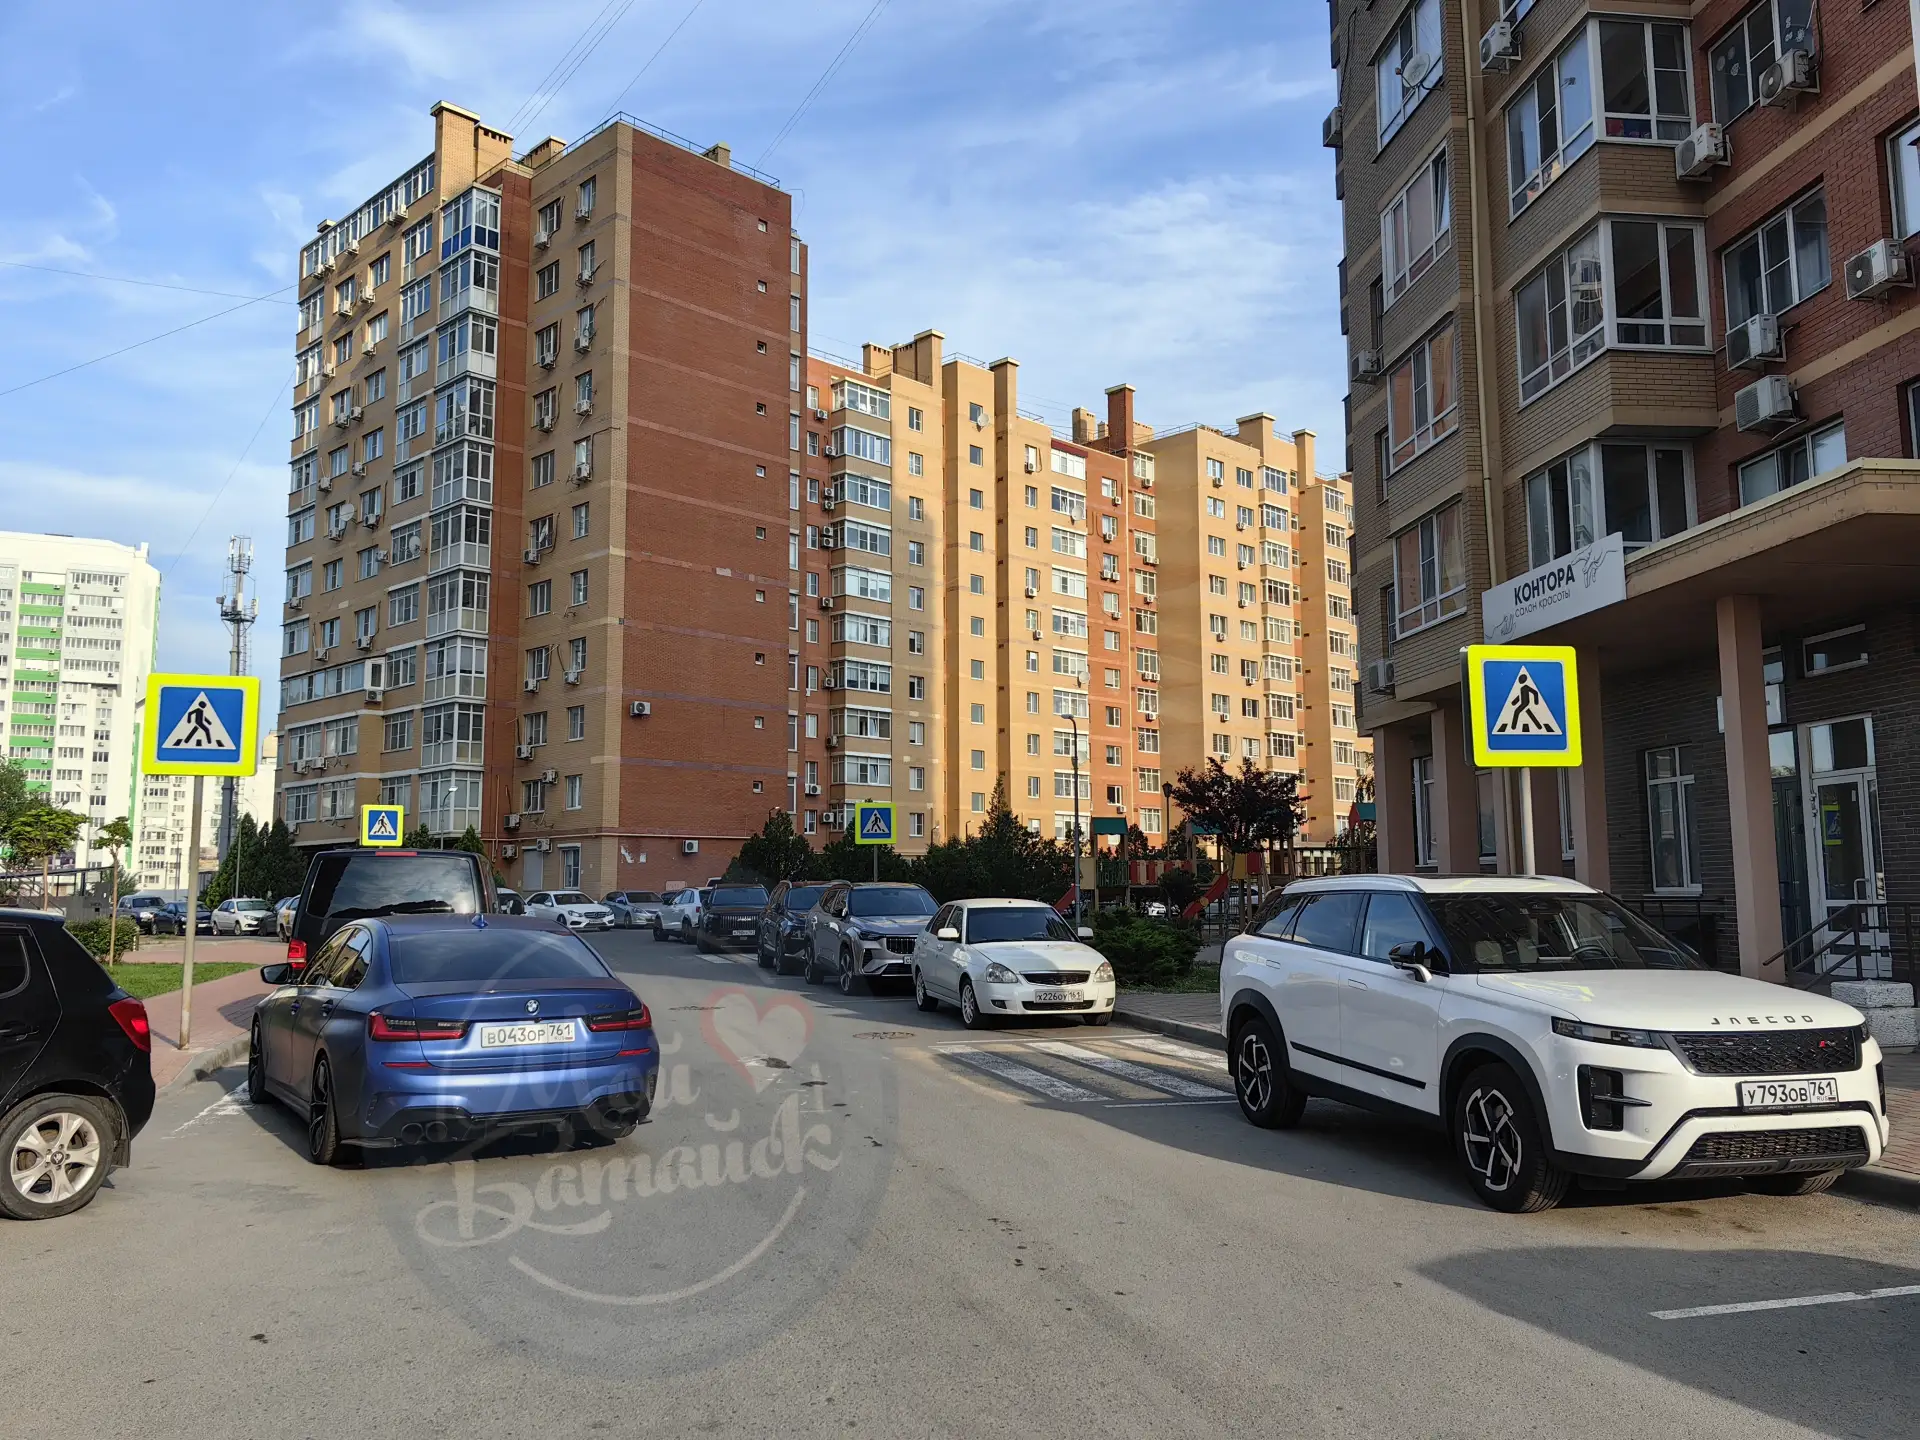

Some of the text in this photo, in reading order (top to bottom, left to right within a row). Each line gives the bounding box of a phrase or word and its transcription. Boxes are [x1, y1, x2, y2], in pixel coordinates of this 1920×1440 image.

[1513, 564, 1576, 606] КОНТОРА
[1514, 589, 1571, 618] салон красоты
[1711, 1015, 1814, 1025] JAECOO
[549, 1024, 571, 1037] 761
[1809, 1081, 1833, 1096] 761
